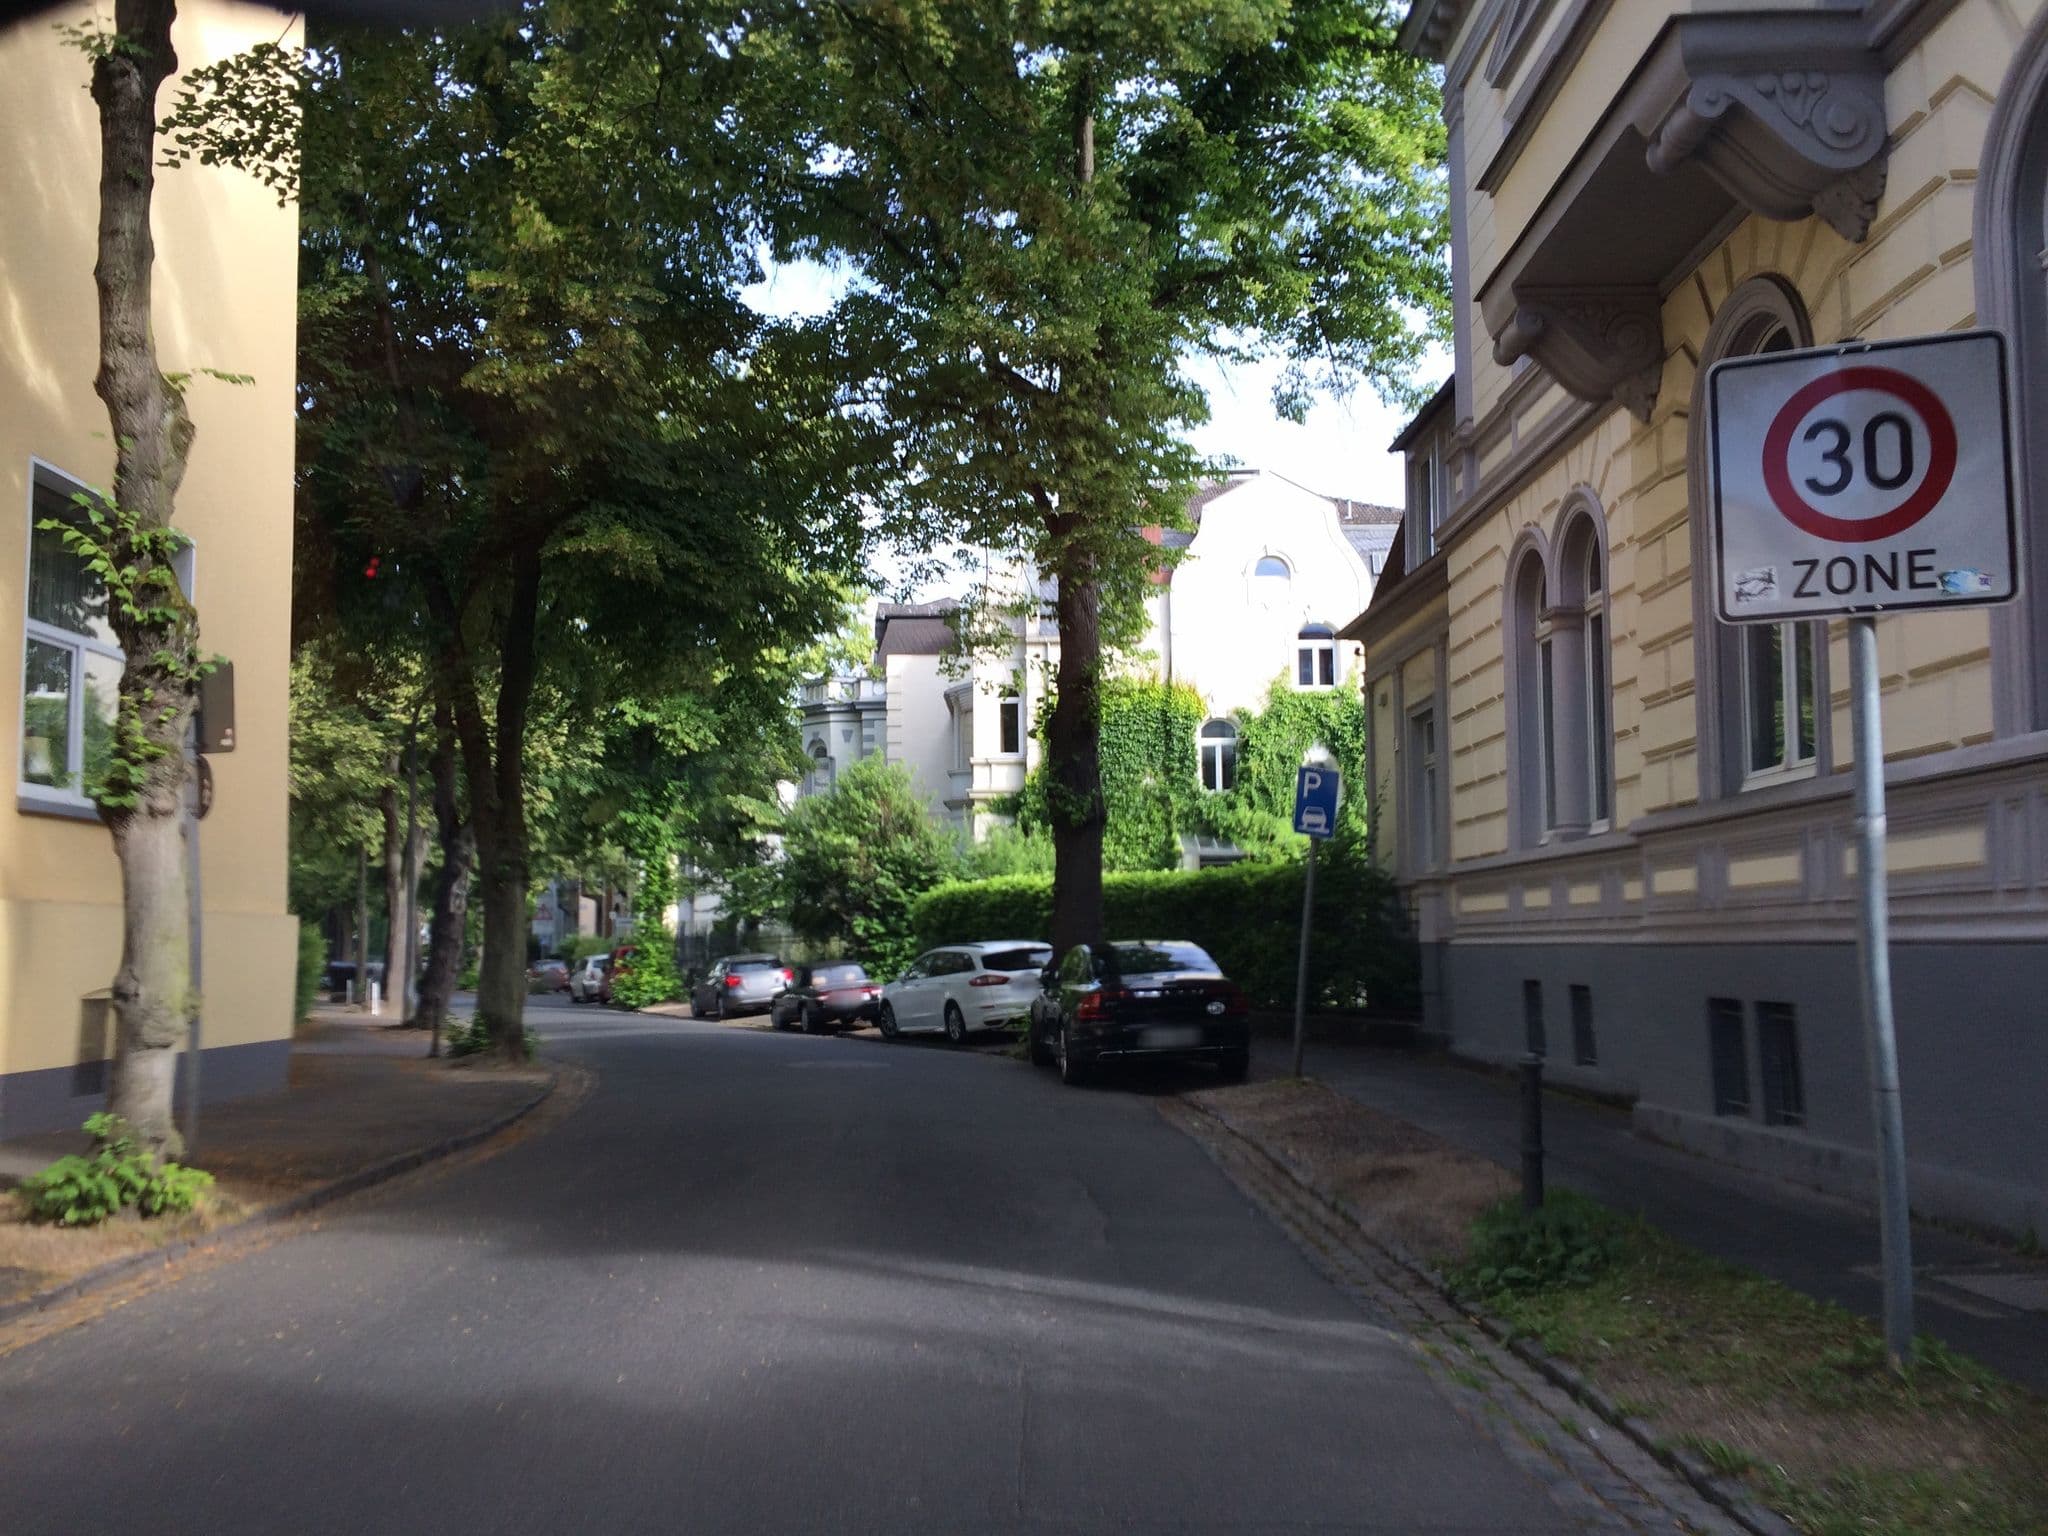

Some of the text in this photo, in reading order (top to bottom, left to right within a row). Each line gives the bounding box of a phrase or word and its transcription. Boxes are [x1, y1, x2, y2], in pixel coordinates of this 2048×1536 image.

[1803, 411, 1914, 497] 30
[1792, 548, 1938, 599] ZONE
[1303, 771, 1322, 799] P
